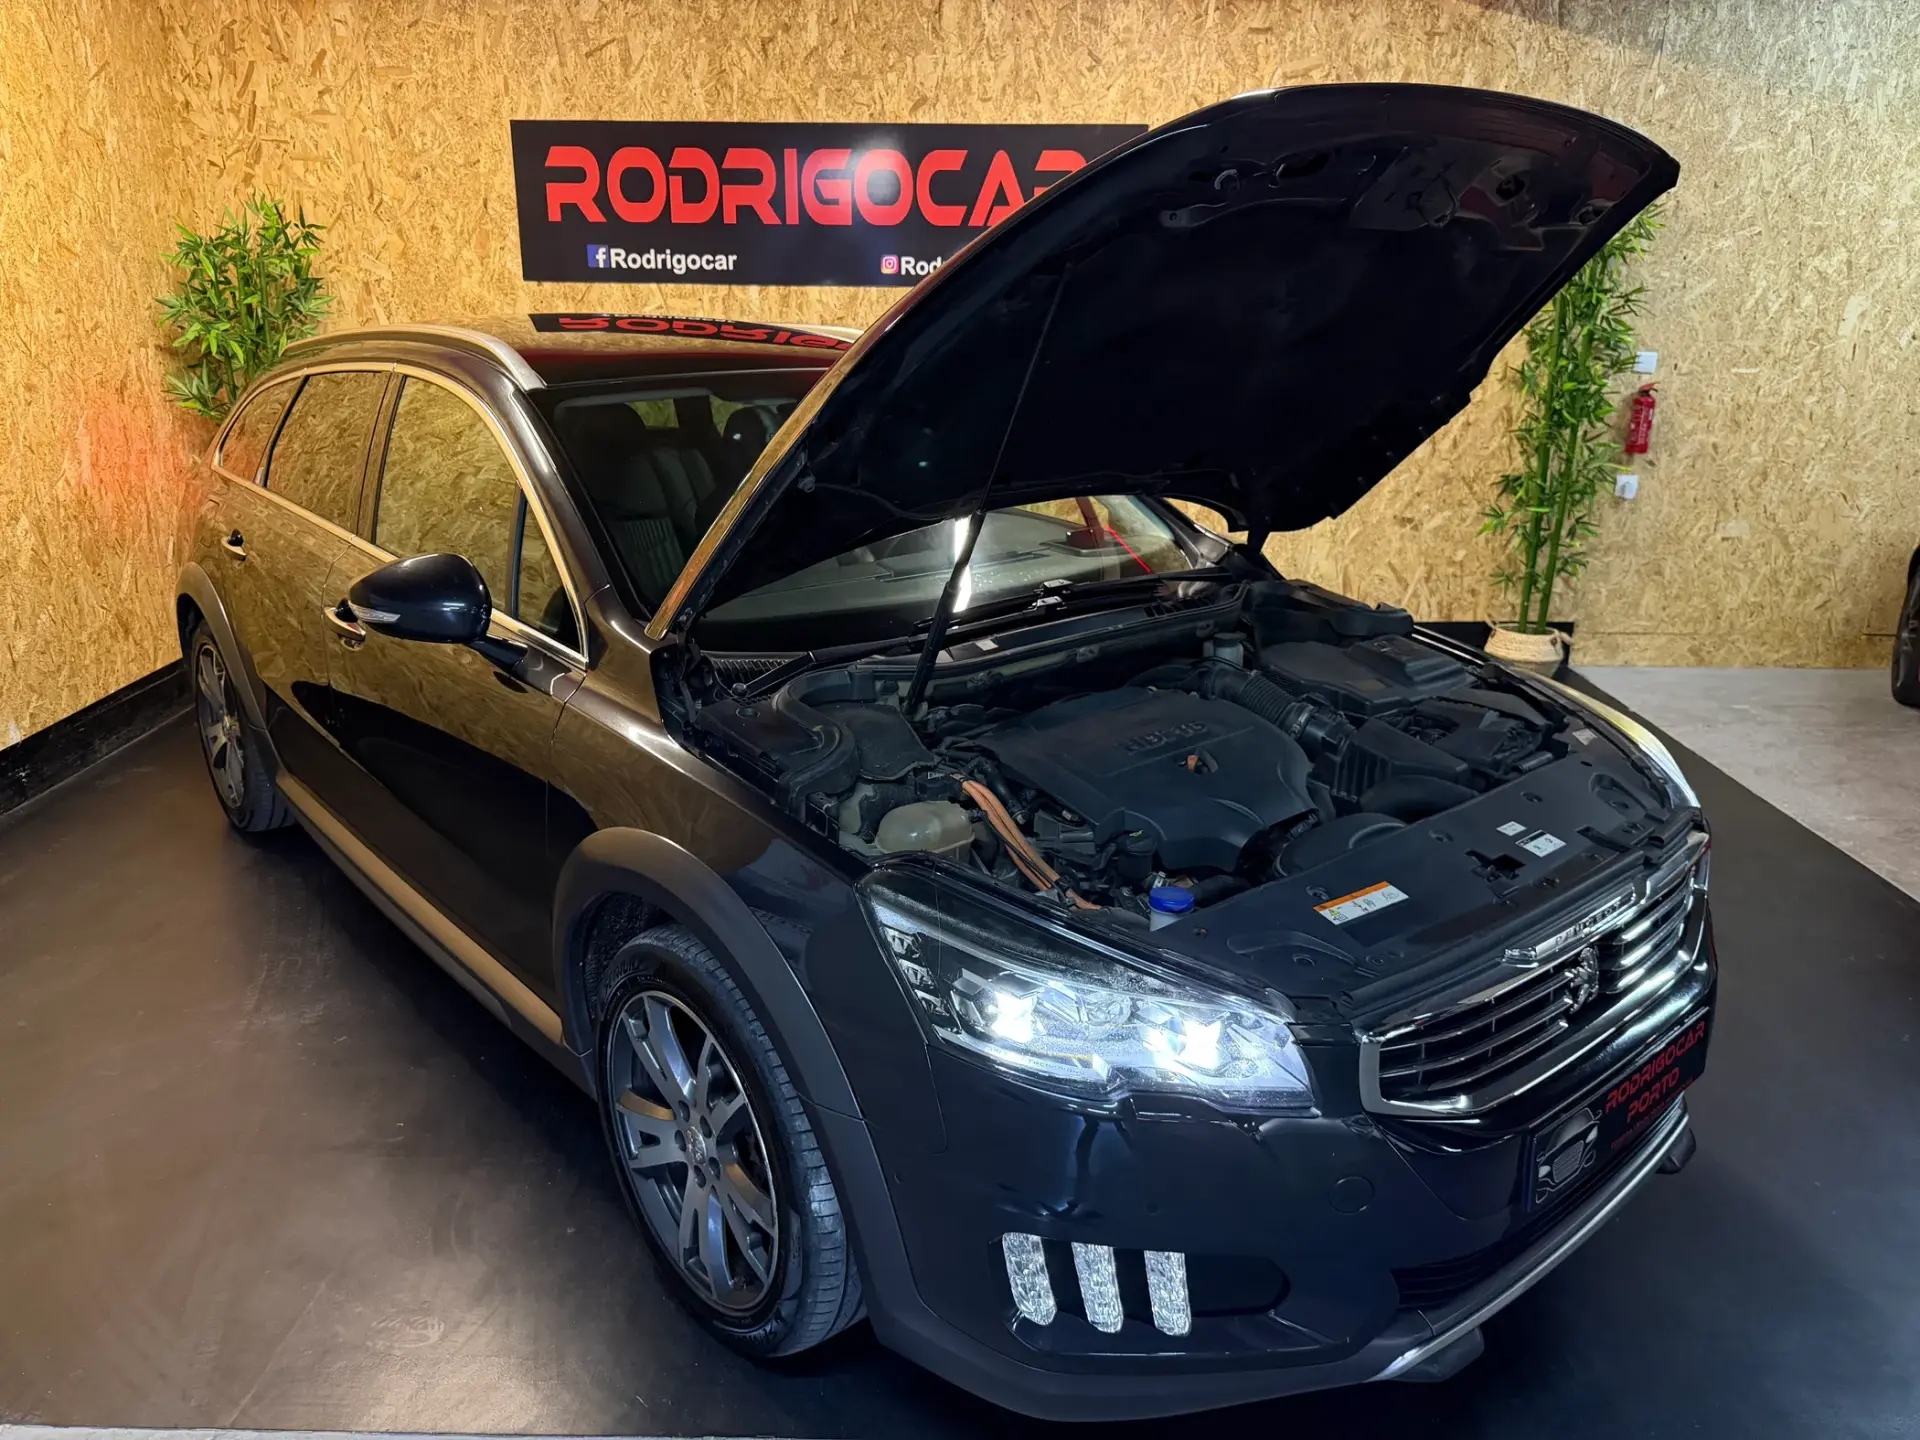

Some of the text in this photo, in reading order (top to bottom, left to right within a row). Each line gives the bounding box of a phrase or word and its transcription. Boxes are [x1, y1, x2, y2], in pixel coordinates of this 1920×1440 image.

[609, 247, 738, 275] Rodrigocar
[1605, 1021, 1705, 1113] RODRIGOCAR
[1627, 1067, 1680, 1122] PORTO
